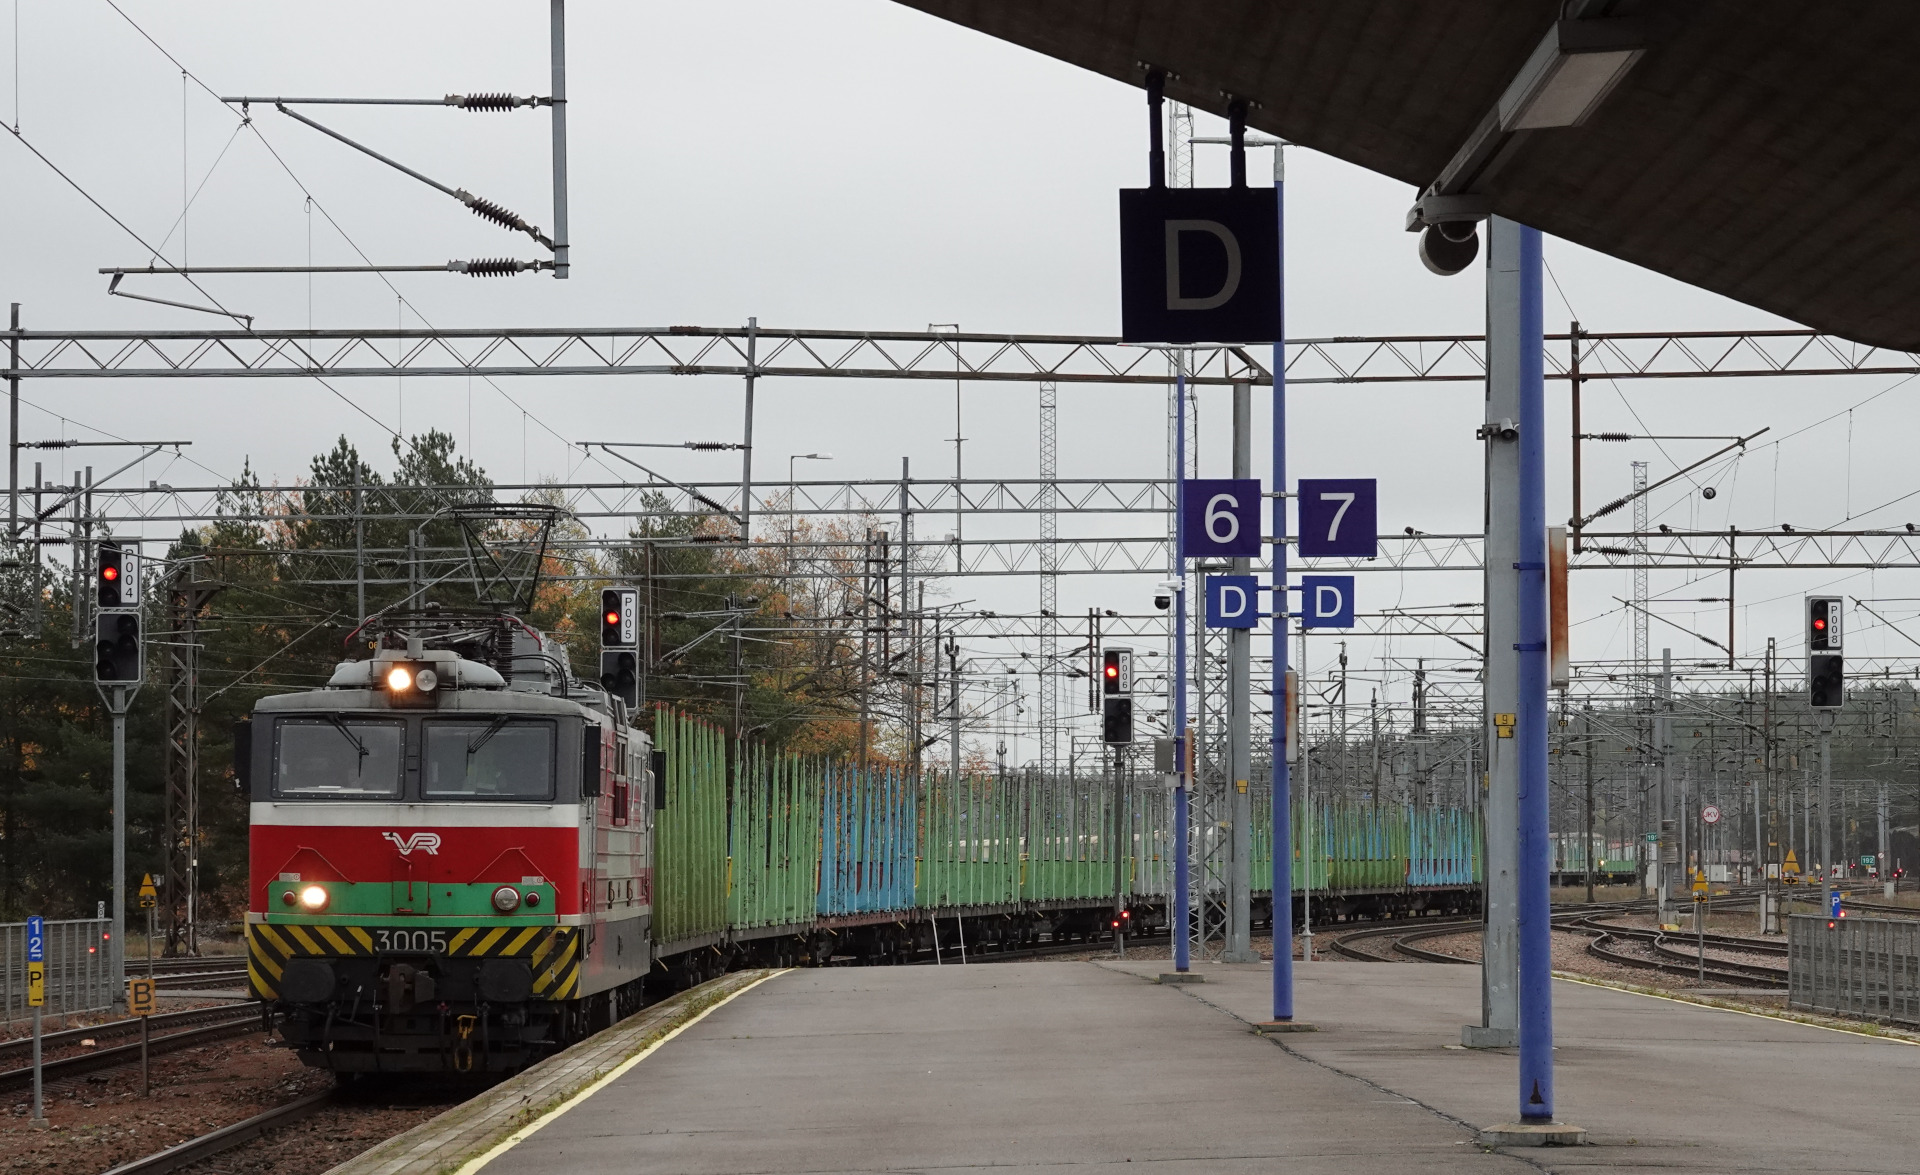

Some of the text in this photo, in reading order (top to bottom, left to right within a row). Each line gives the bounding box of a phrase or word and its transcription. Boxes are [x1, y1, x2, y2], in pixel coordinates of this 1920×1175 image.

[1165, 219, 1242, 311] D
[1204, 493, 1240, 544] 6
[1319, 492, 1356, 542] 7
[624, 596, 633, 640] P005
[1219, 585, 1247, 618] D
[1315, 585, 1343, 618] D
[1830, 605, 1838, 644] P008
[381, 831, 442, 856] VR
[1832, 896, 1840, 907] P
[375, 930, 447, 953] 3005
[30, 971, 42, 986] P
[134, 982, 152, 1005] B
